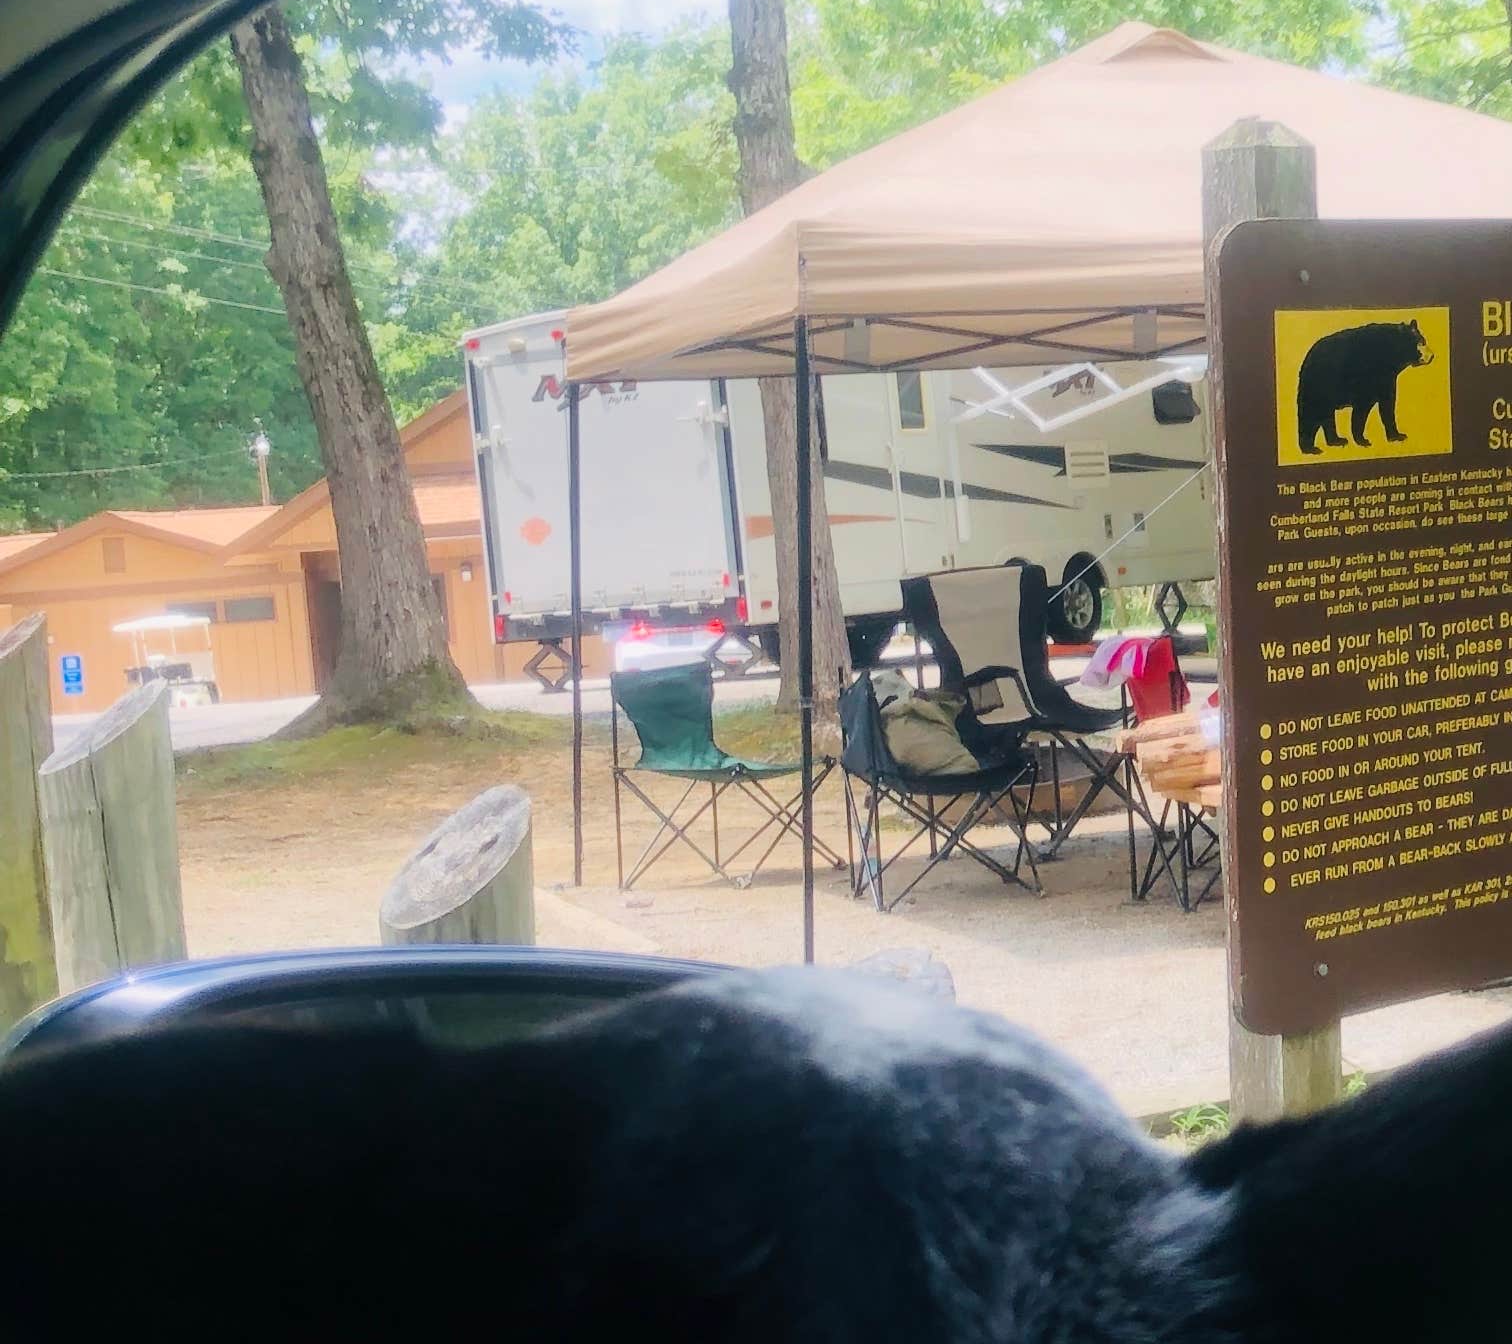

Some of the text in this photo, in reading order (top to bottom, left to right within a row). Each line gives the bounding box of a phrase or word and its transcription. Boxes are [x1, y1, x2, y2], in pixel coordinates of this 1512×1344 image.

[1260, 642, 1286, 659] We
[1291, 636, 1331, 656] need
[1337, 633, 1372, 653] your
[1418, 623, 1436, 639] To
[1441, 616, 1494, 639] protect
[1267, 665, 1305, 682] have
[1311, 662, 1330, 677] an
[1336, 650, 1410, 673] enjoyable
[1415, 643, 1450, 661] visit,
[1455, 639, 1503, 659] please
[1367, 673, 1399, 691] with
[1404, 670, 1429, 686] the
[1434, 661, 1499, 681] following
[1278, 720, 1297, 736] DO
[1300, 716, 1324, 732] NOT
[1327, 710, 1362, 728] LEAVE
[1365, 705, 1398, 721] FOOD
[1400, 694, 1471, 716] UNATTENDED
[1474, 691, 1487, 705] AT
[1279, 742, 1318, 760] STORE
[1321, 736, 1354, 753] FOOD
[1357, 733, 1370, 748] IN
[1372, 728, 1403, 744] YOUR
[1406, 724, 1433, 739] CAR,
[1435, 713, 1501, 734] PREFERABLY
[1279, 742, 1486, 788] NO FOOD IN OR AROUND YOUR TENT.
[1280, 798, 1299, 813] DO
[1302, 793, 1326, 810] NOT
[1329, 786, 1364, 804] LEAVE
[1367, 777, 1420, 797] GARBAGE
[1423, 768, 1469, 787] OUTSIDE
[1472, 764, 1488, 779] OF
[1281, 820, 1320, 838] NEVER
[1323, 813, 1350, 830] GIVE
[1353, 802, 1414, 824] HANDOUTS
[1416, 798, 1432, 812] TO
[1281, 848, 1300, 864] DO
[1303, 843, 1327, 859] NOT
[1330, 832, 1390, 853] APPROACH
[1393, 829, 1402, 842] A
[1404, 822, 1434, 840] BEAR
[1446, 815, 1475, 831] THEY
[1477, 810, 1499, 825] ARE
[1290, 869, 1321, 887] EVER
[1324, 864, 1349, 880] RUN
[1352, 857, 1384, 874] FROM
[1387, 854, 1396, 868] A
[1465, 833, 1506, 852] SLOWLY
